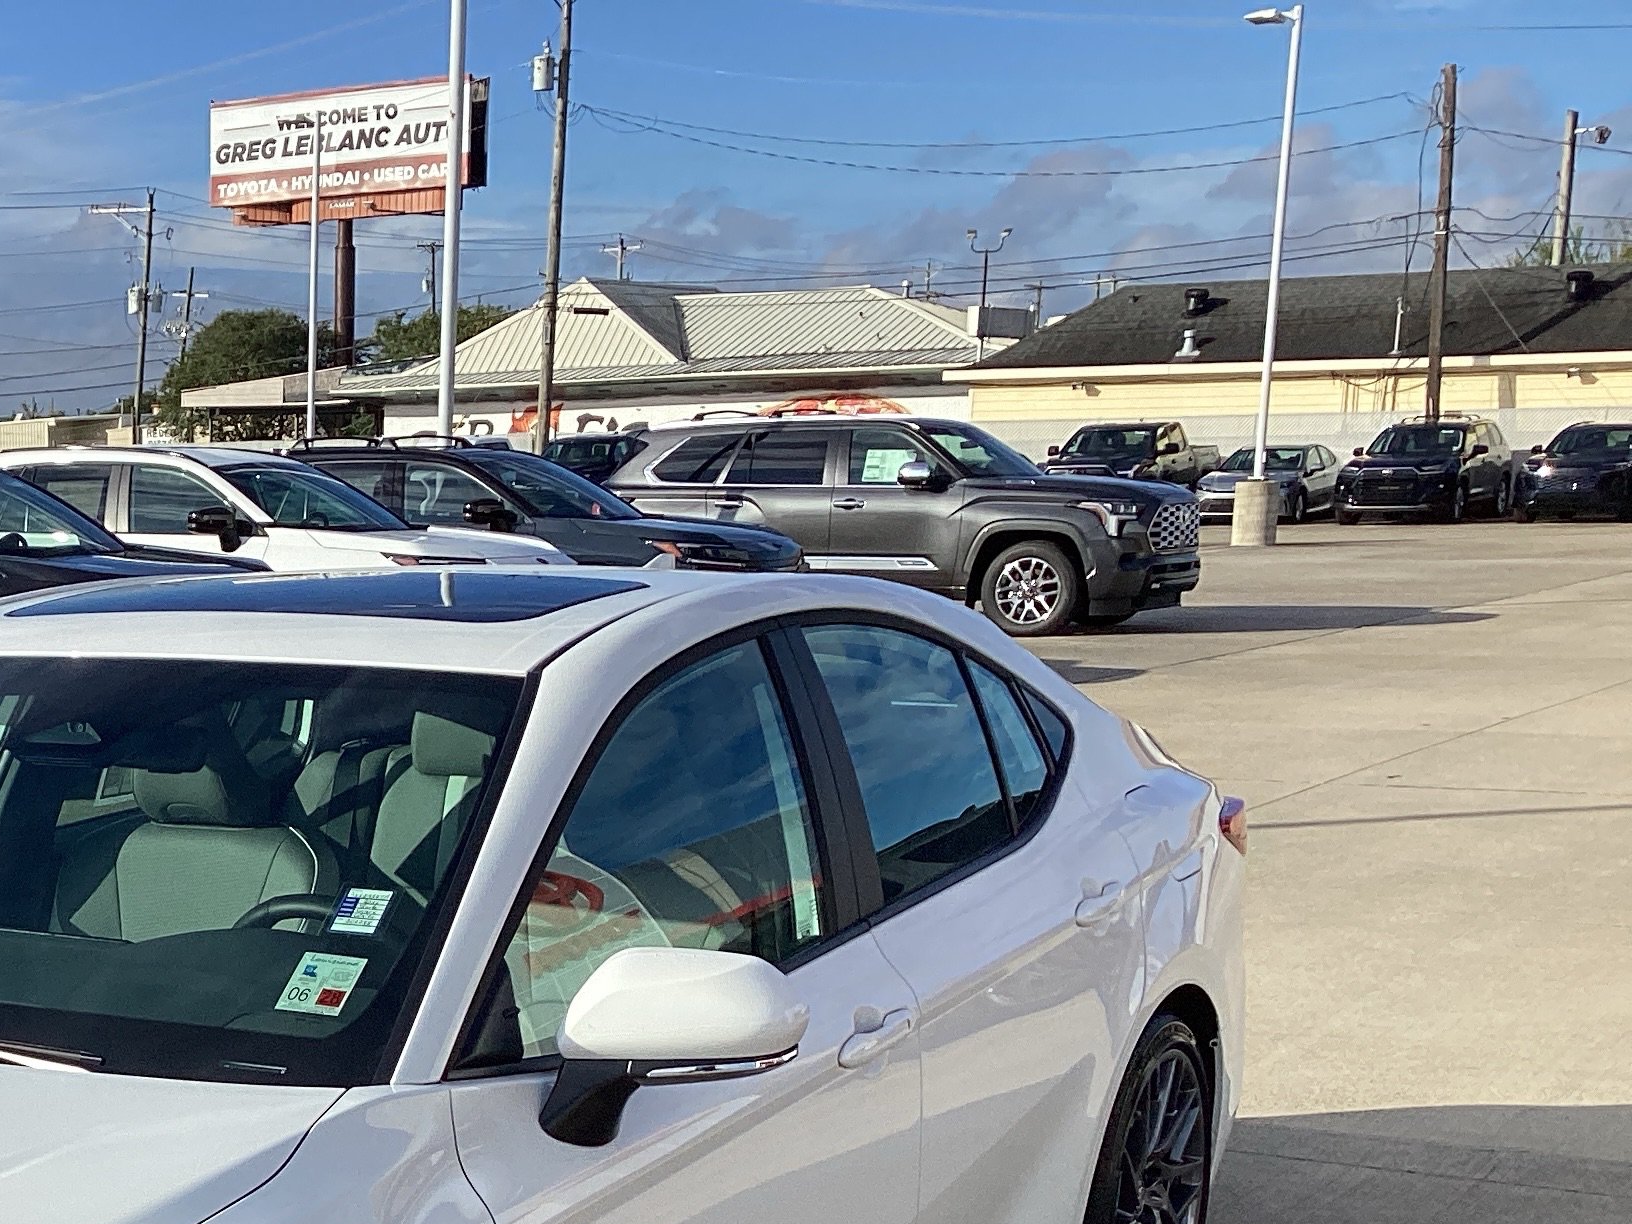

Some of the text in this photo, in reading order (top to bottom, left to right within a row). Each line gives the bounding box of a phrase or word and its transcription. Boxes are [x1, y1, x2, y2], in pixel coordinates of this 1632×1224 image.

[373, 103, 398, 121] TO
[216, 137, 277, 165] GREG
[394, 120, 449, 147] AUT
[217, 178, 279, 199] TOYOTA
[373, 165, 415, 183] USED
[418, 162, 449, 180] CAR
[287, 986, 312, 1002] 06
